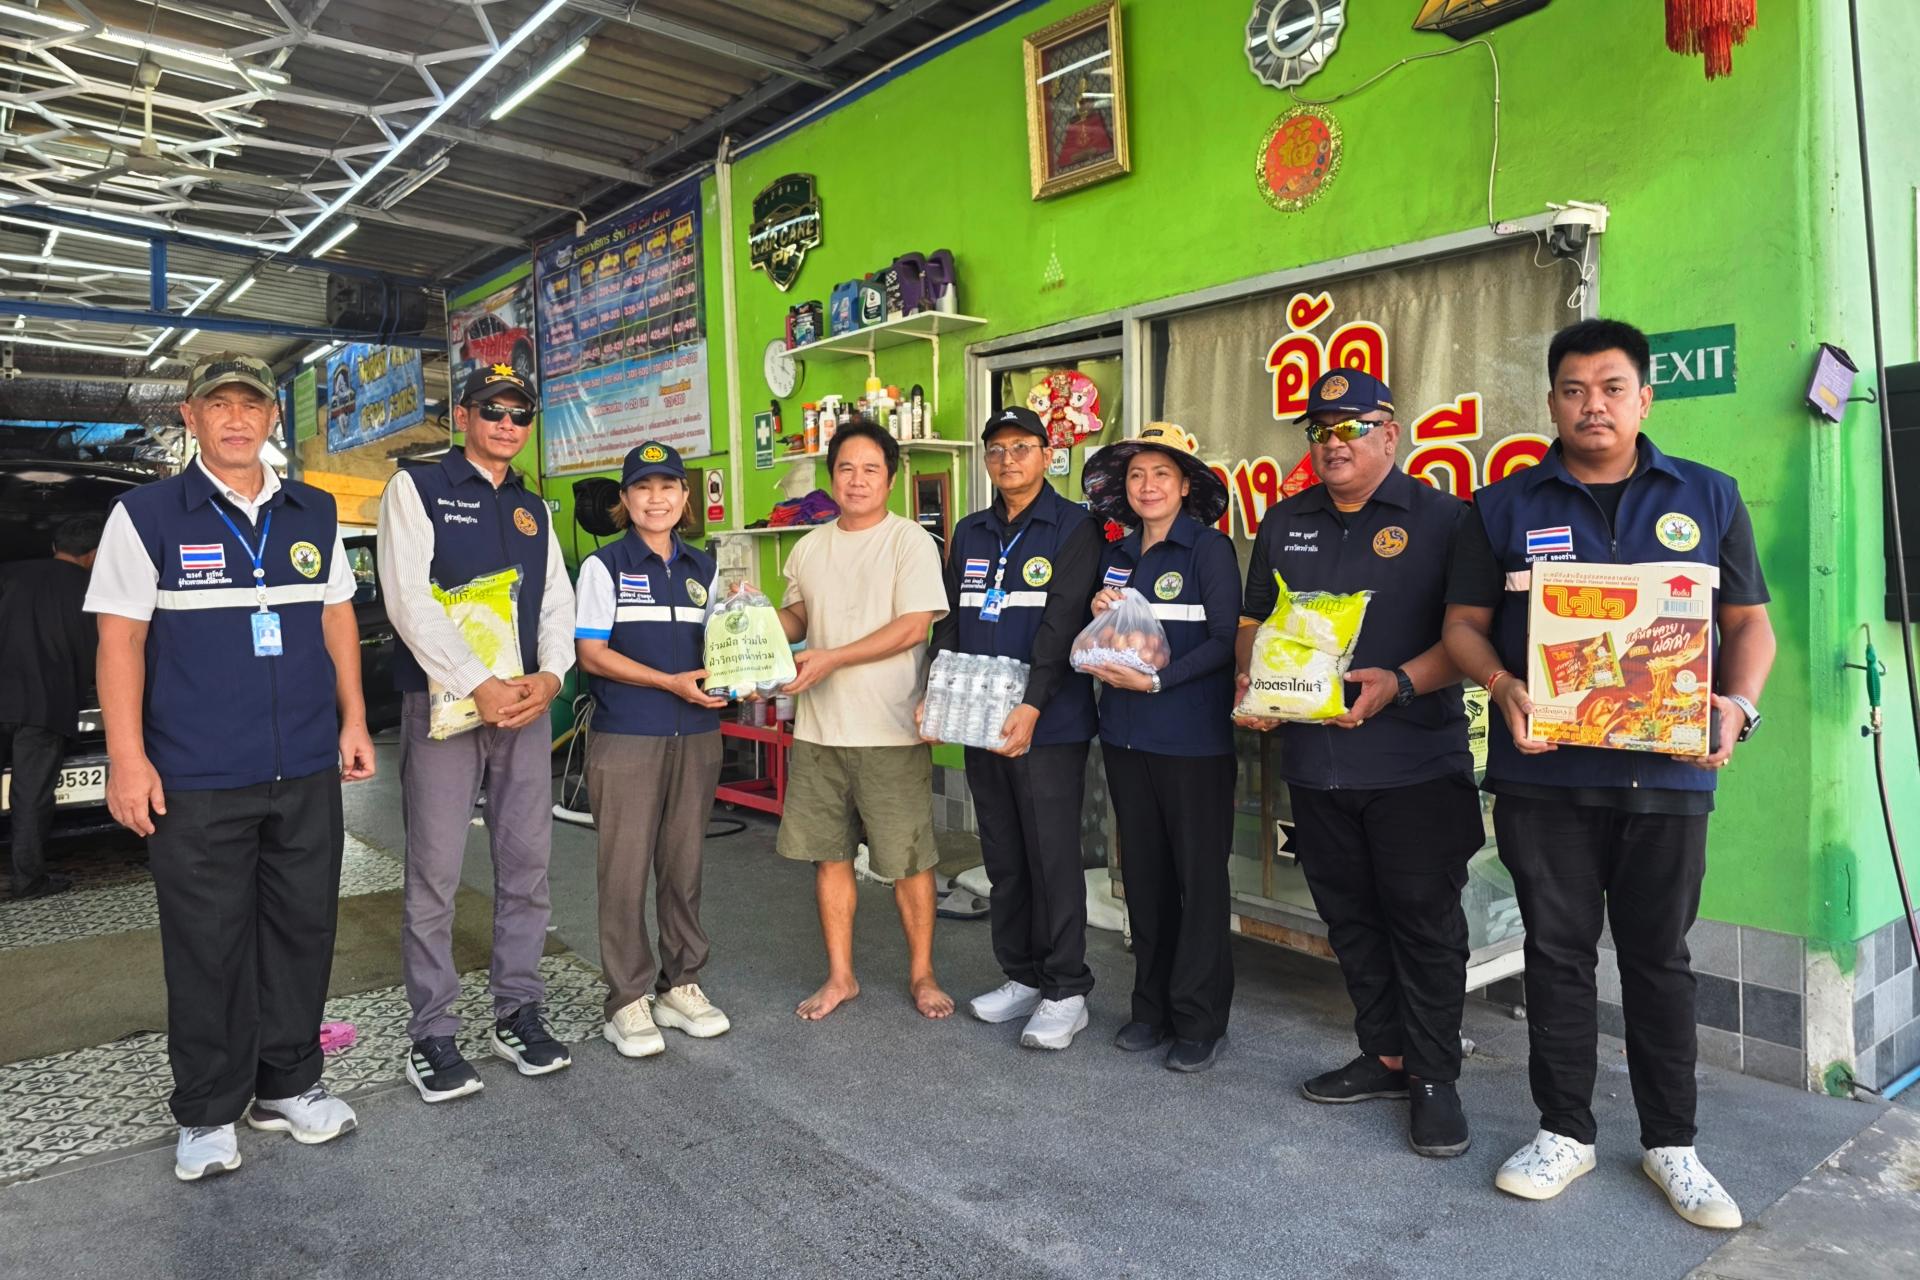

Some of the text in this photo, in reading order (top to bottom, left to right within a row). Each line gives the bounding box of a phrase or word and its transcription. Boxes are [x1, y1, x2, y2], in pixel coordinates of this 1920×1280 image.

[1278, 120, 1318, 168] 福
[627, 223, 638, 238] PP
[653, 207, 671, 223] Care
[752, 220, 815, 255] CAR CARE
[1649, 345, 1731, 385] EXIT
[1545, 586, 1625, 619] ไวไว
[710, 634, 768, 651] ร่วมมือ ร่วมใจ
[1254, 677, 1322, 693] ข้าวตราไก่แจ้
